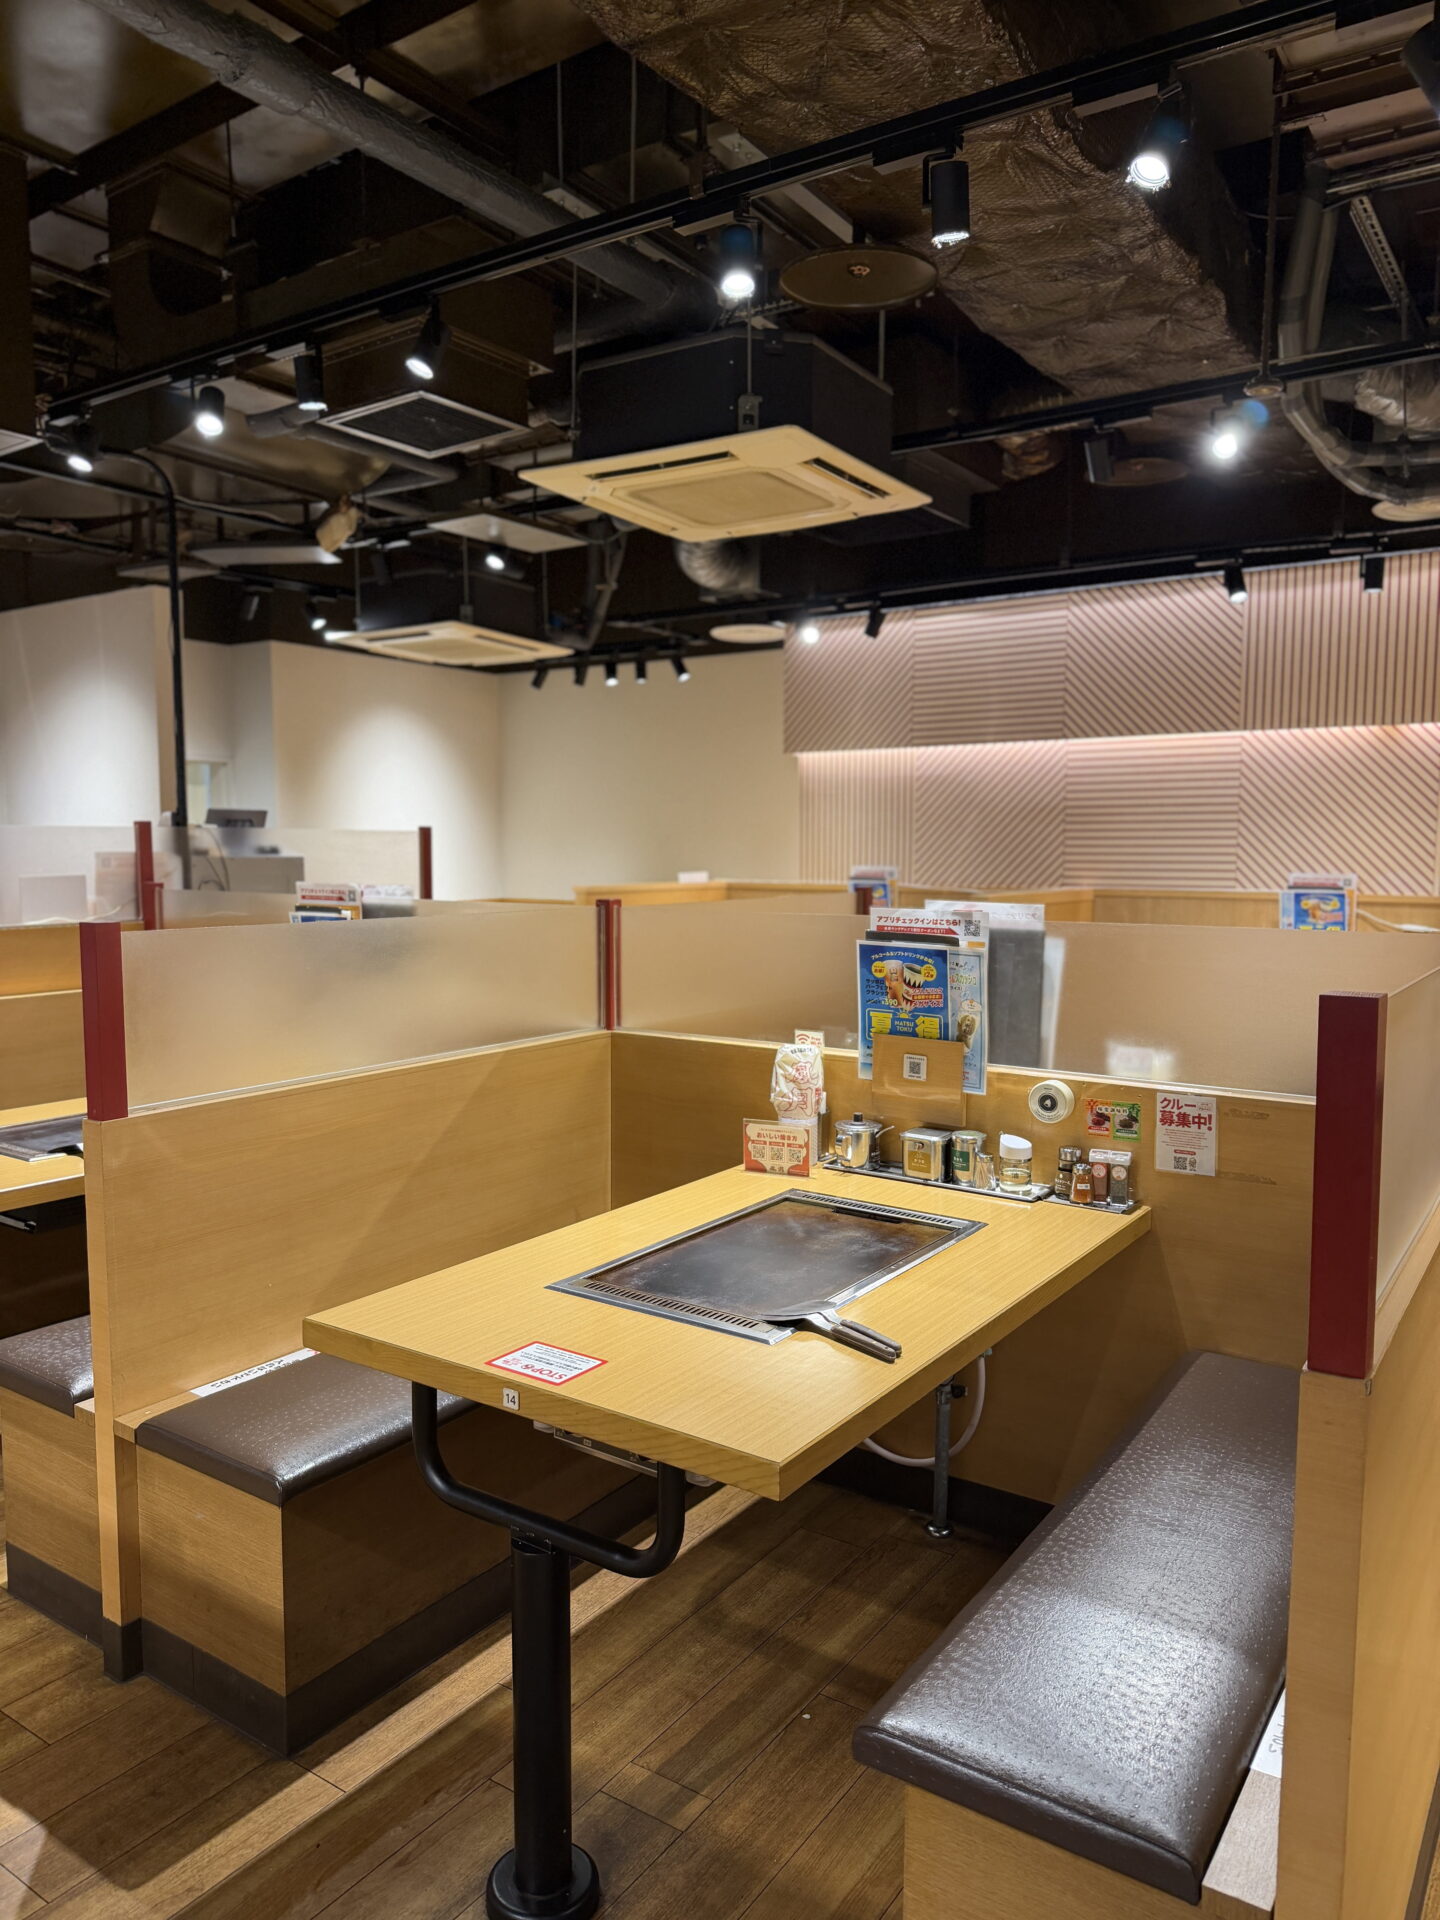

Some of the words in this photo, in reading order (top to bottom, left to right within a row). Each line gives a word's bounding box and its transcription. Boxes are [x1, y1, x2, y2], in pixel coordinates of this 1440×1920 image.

[1159, 1097, 1197, 1111] クルー
[1159, 1110, 1213, 1132] 募集中!
[532, 1366, 567, 1380] STOP
[505, 1393, 516, 1406] 14
